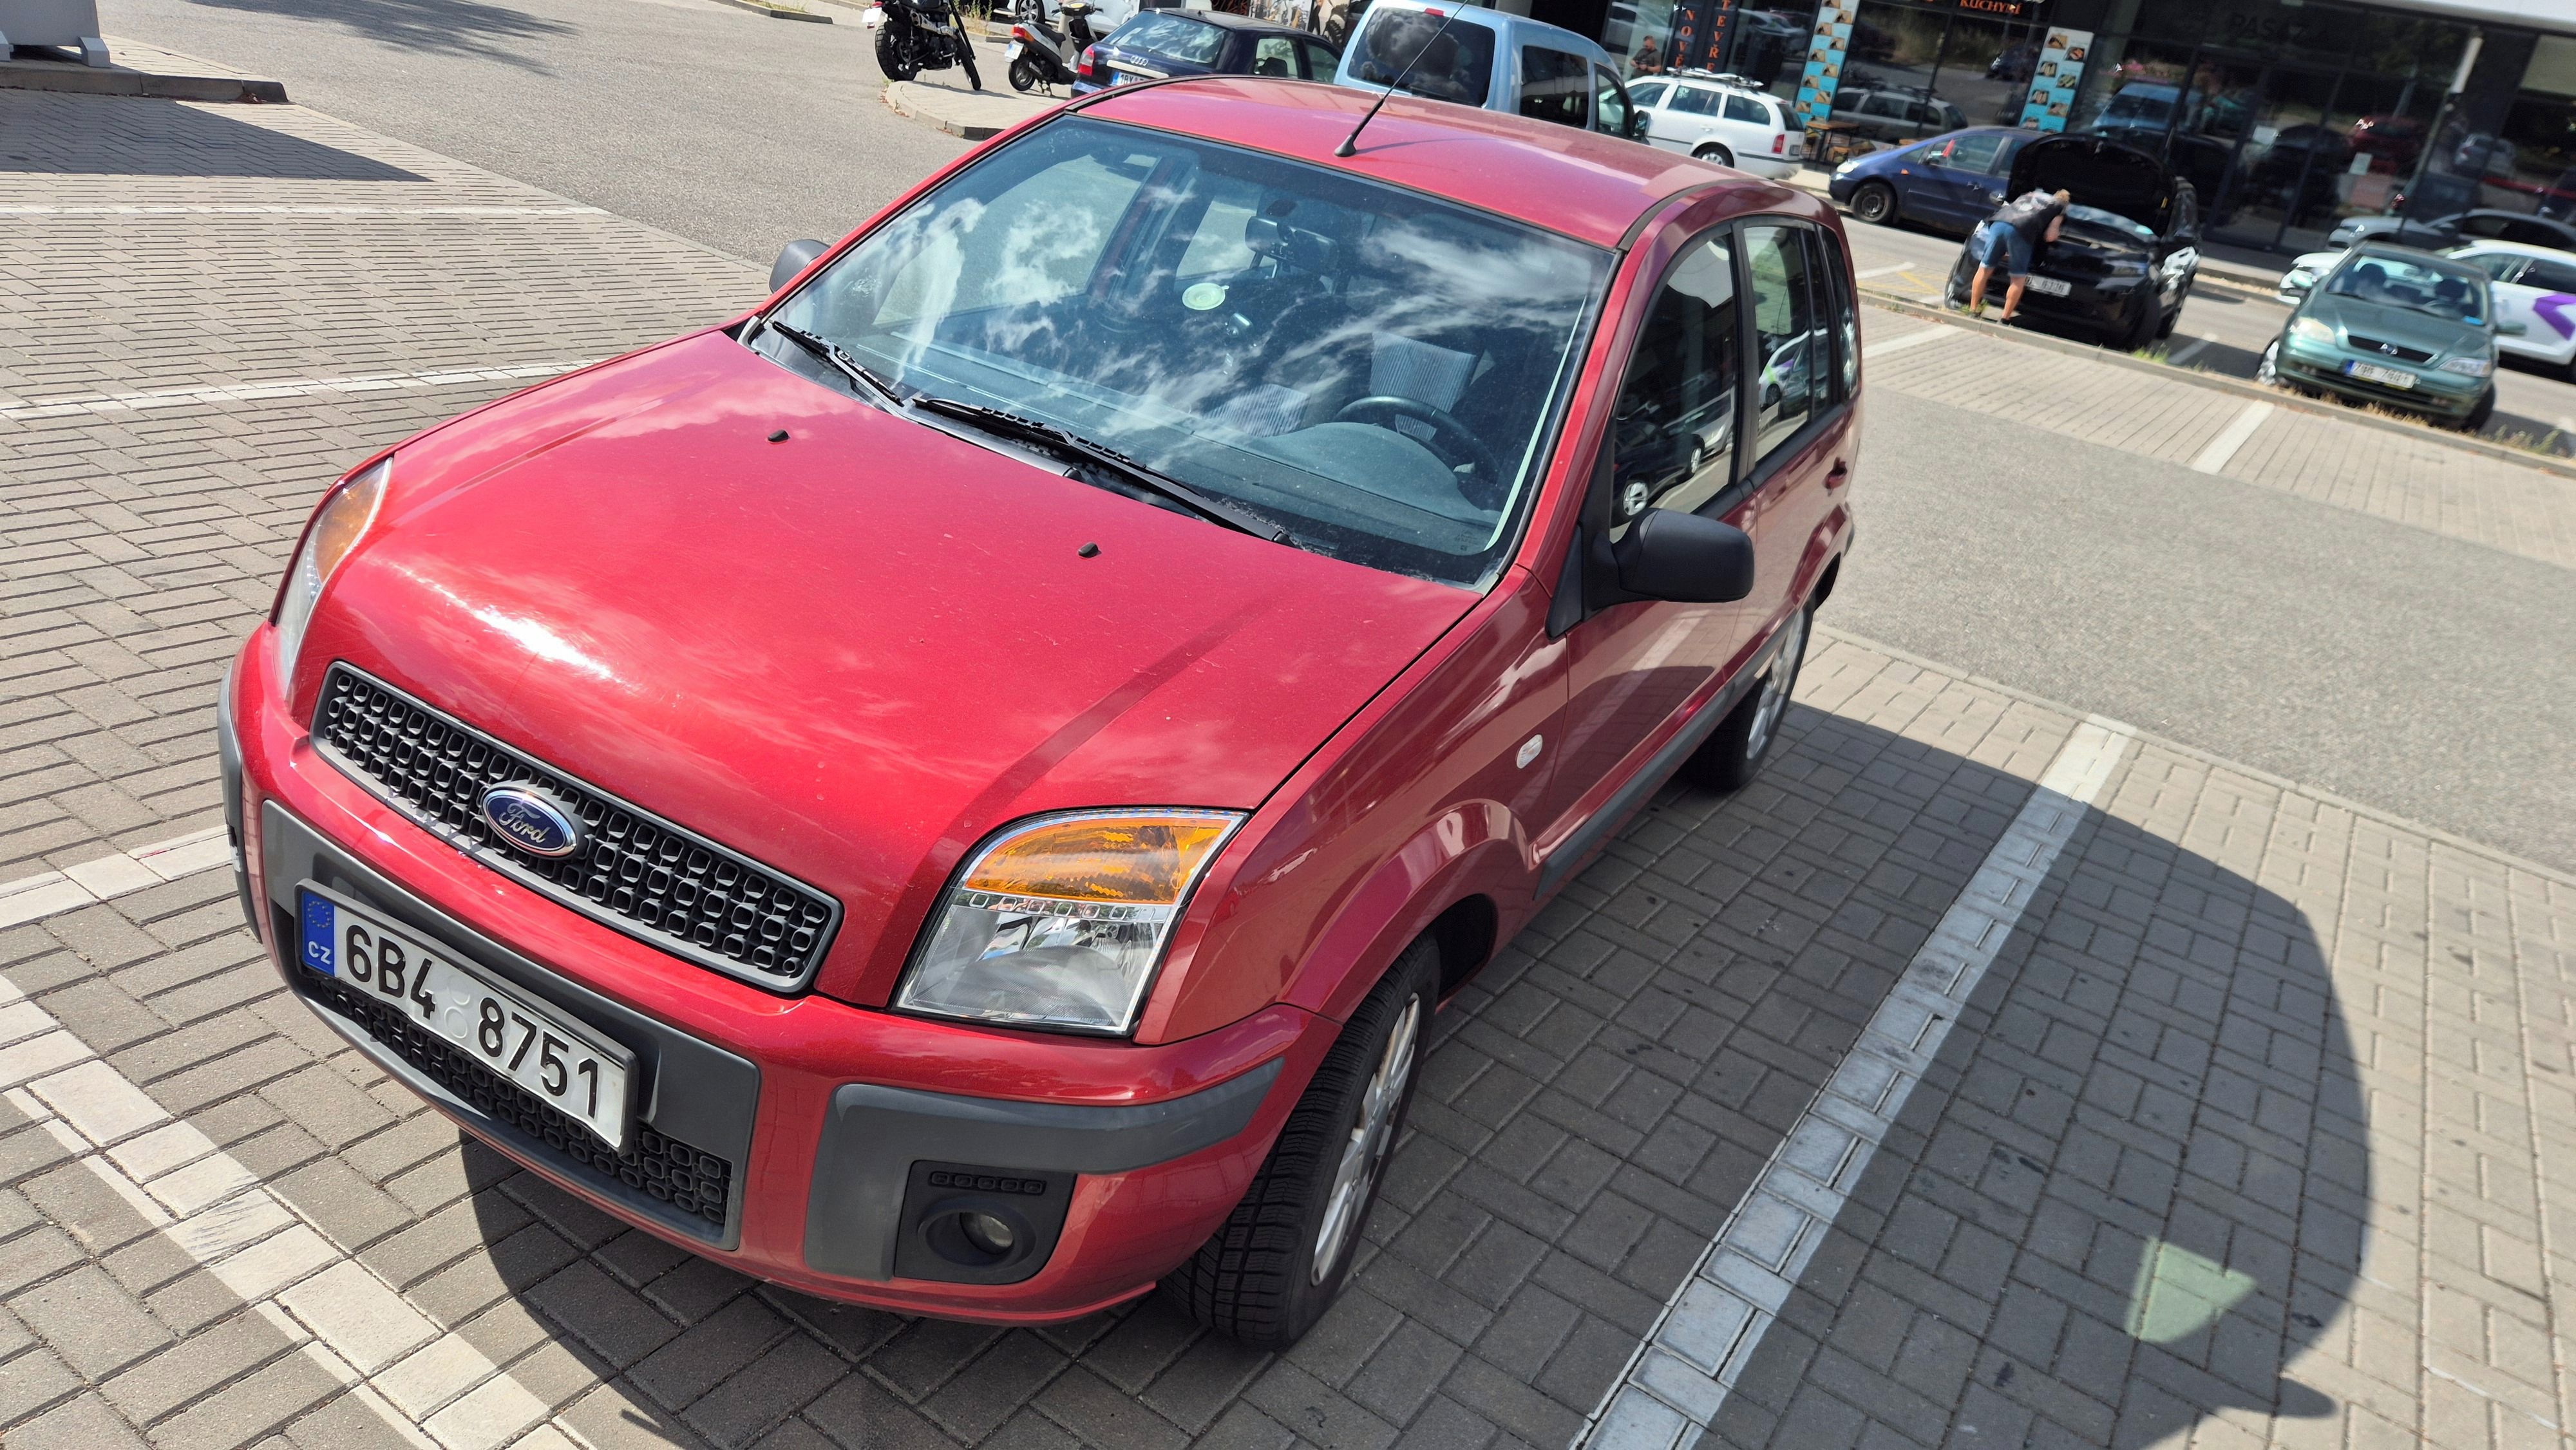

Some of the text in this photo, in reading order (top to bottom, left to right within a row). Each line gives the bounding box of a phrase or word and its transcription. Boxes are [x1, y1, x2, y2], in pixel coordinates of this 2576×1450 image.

[498, 803, 550, 843] Ford
[308, 941, 332, 965] CZ
[346, 925, 599, 1120] 6B4 8751
